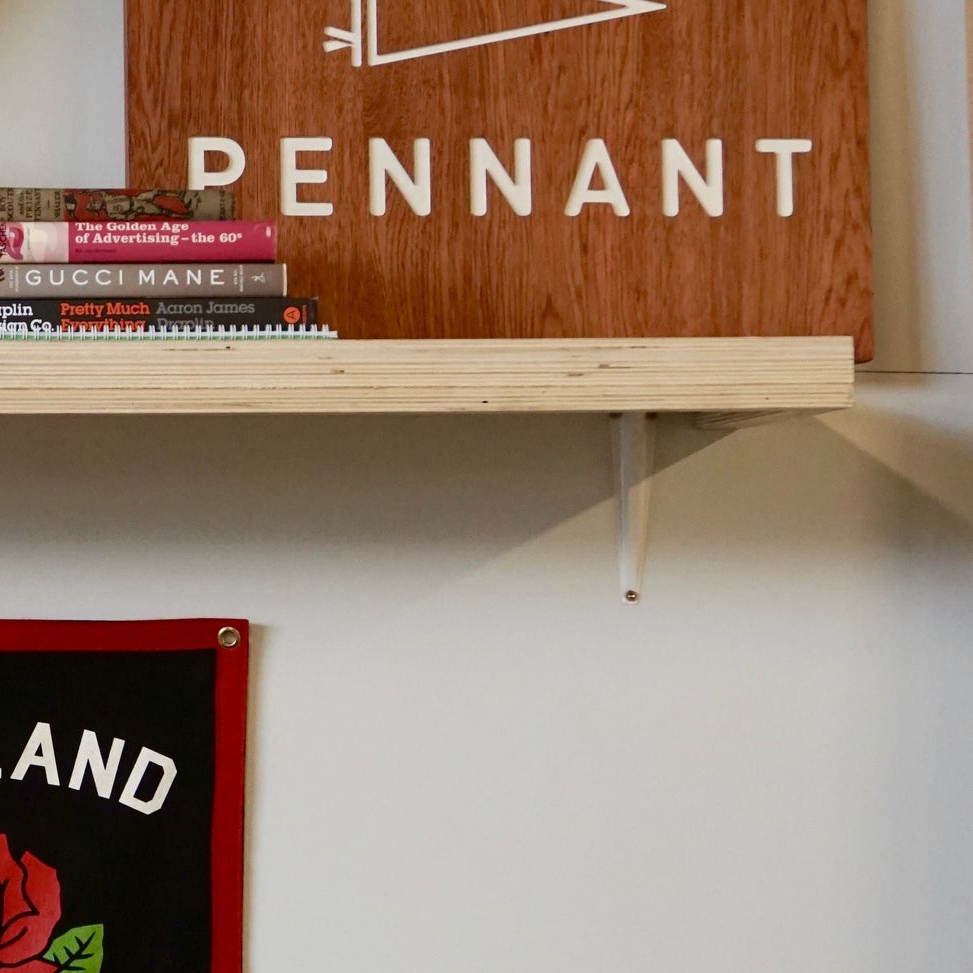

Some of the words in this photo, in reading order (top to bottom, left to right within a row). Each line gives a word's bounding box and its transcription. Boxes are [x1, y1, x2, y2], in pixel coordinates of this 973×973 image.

[187, 137, 813, 218] PENNANT
[0, 196, 7, 212] BOY
[7, 188, 15, 221] SCOUTS
[25, 189, 33, 219] PRIZE
[34, 188, 42, 222] PENNANT
[75, 222, 103, 232] The
[106, 222, 157, 232] Golden
[160, 222, 189, 234] Age
[75, 233, 89, 243] of
[25, 269, 123, 286] GUCCI
[138, 269, 225, 286] MANE
[60, 302, 104, 318] Pretty
[106, 302, 150, 316] Much
[156, 302, 203, 316] Aaron
[206, 302, 256, 316] James
[30, 319, 55, 332] Co.
[60, 318, 146, 332] Everything
[156, 317, 215, 331] Draplin
